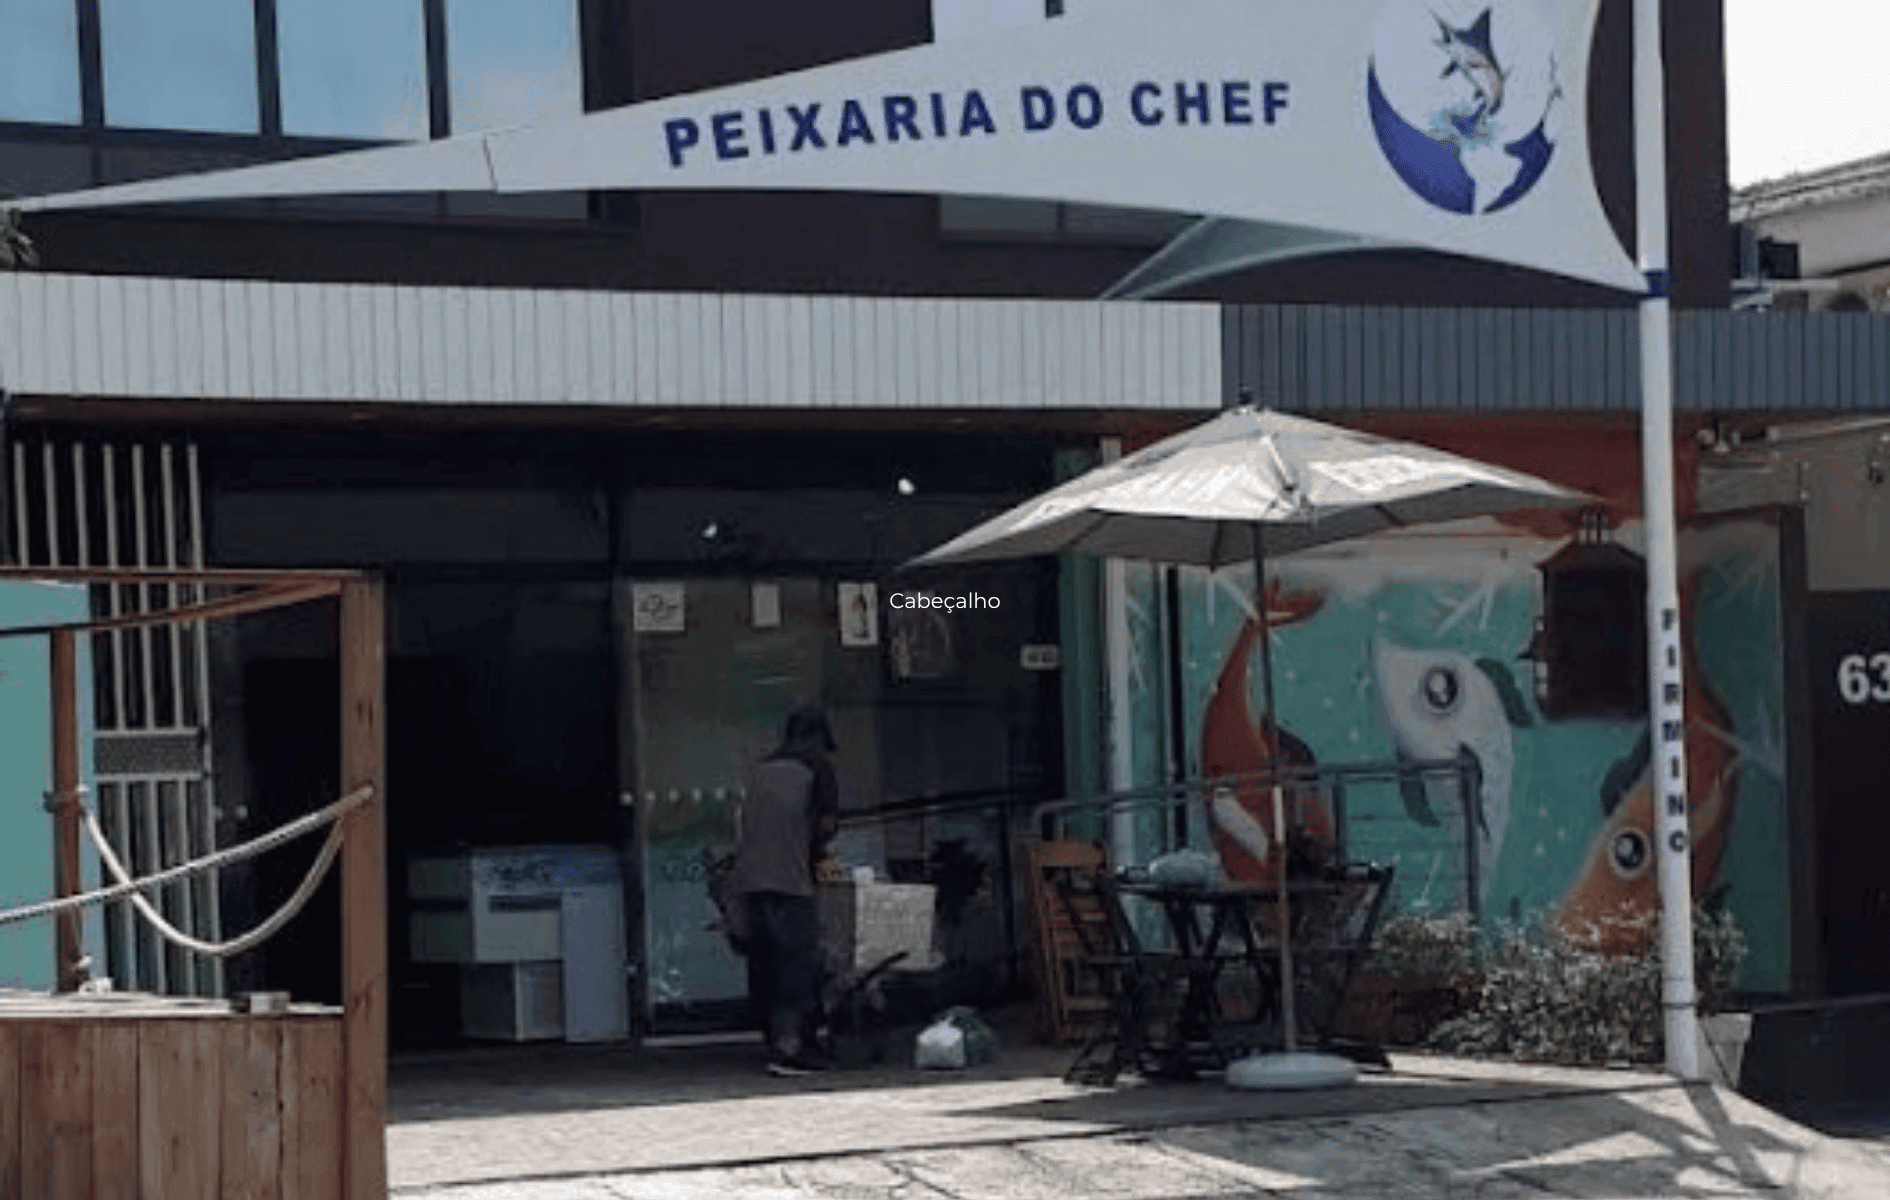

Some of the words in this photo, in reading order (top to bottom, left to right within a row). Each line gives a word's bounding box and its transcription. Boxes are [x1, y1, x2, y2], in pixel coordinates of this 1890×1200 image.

[663, 89, 997, 167] PEIXARIA
[1021, 83, 1104, 132] DO
[1131, 80, 1290, 128] CHEF
